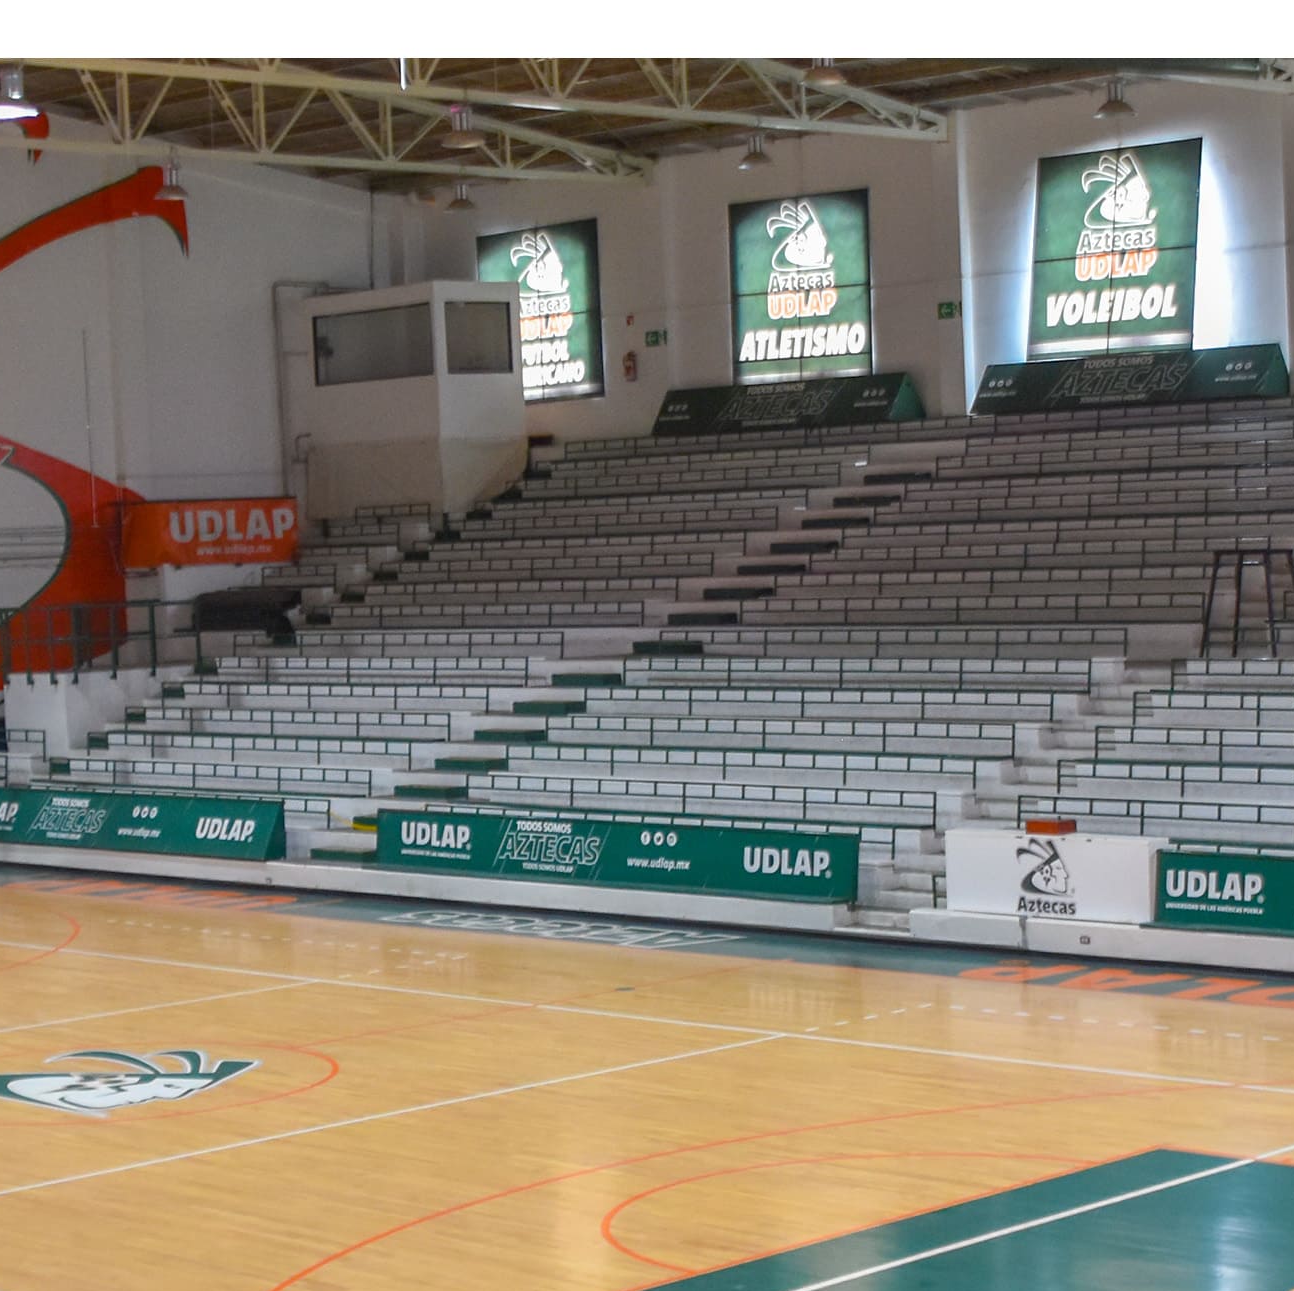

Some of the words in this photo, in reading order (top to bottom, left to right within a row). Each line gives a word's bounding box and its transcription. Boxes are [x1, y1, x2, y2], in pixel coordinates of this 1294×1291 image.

[1077, 230, 1156, 255] Aztecas
[1075, 249, 1159, 281] UDLAP
[769, 272, 835, 293] Aztecas
[767, 288, 837, 320] UDLAP
[1045, 284, 1177, 327] VOLEIBOL
[739, 322, 866, 362] ATLETISMO
[1050, 363, 1188, 398] AZTECAS
[169, 507, 295, 543] UDLAP
[31, 806, 107, 834] AZTECAS
[195, 817, 255, 842] UDLAP
[401, 821, 470, 850] UDLAP
[516, 820, 543, 832] TODOS
[543, 822, 572, 835] SOMOS
[499, 831, 601, 866] AZTECAS
[627, 857, 690, 872] www.udlap.mx
[743, 846, 821, 879] UDLAP
[1165, 869, 1264, 903] UDLAP
[1017, 896, 1076, 915] Aztecas
